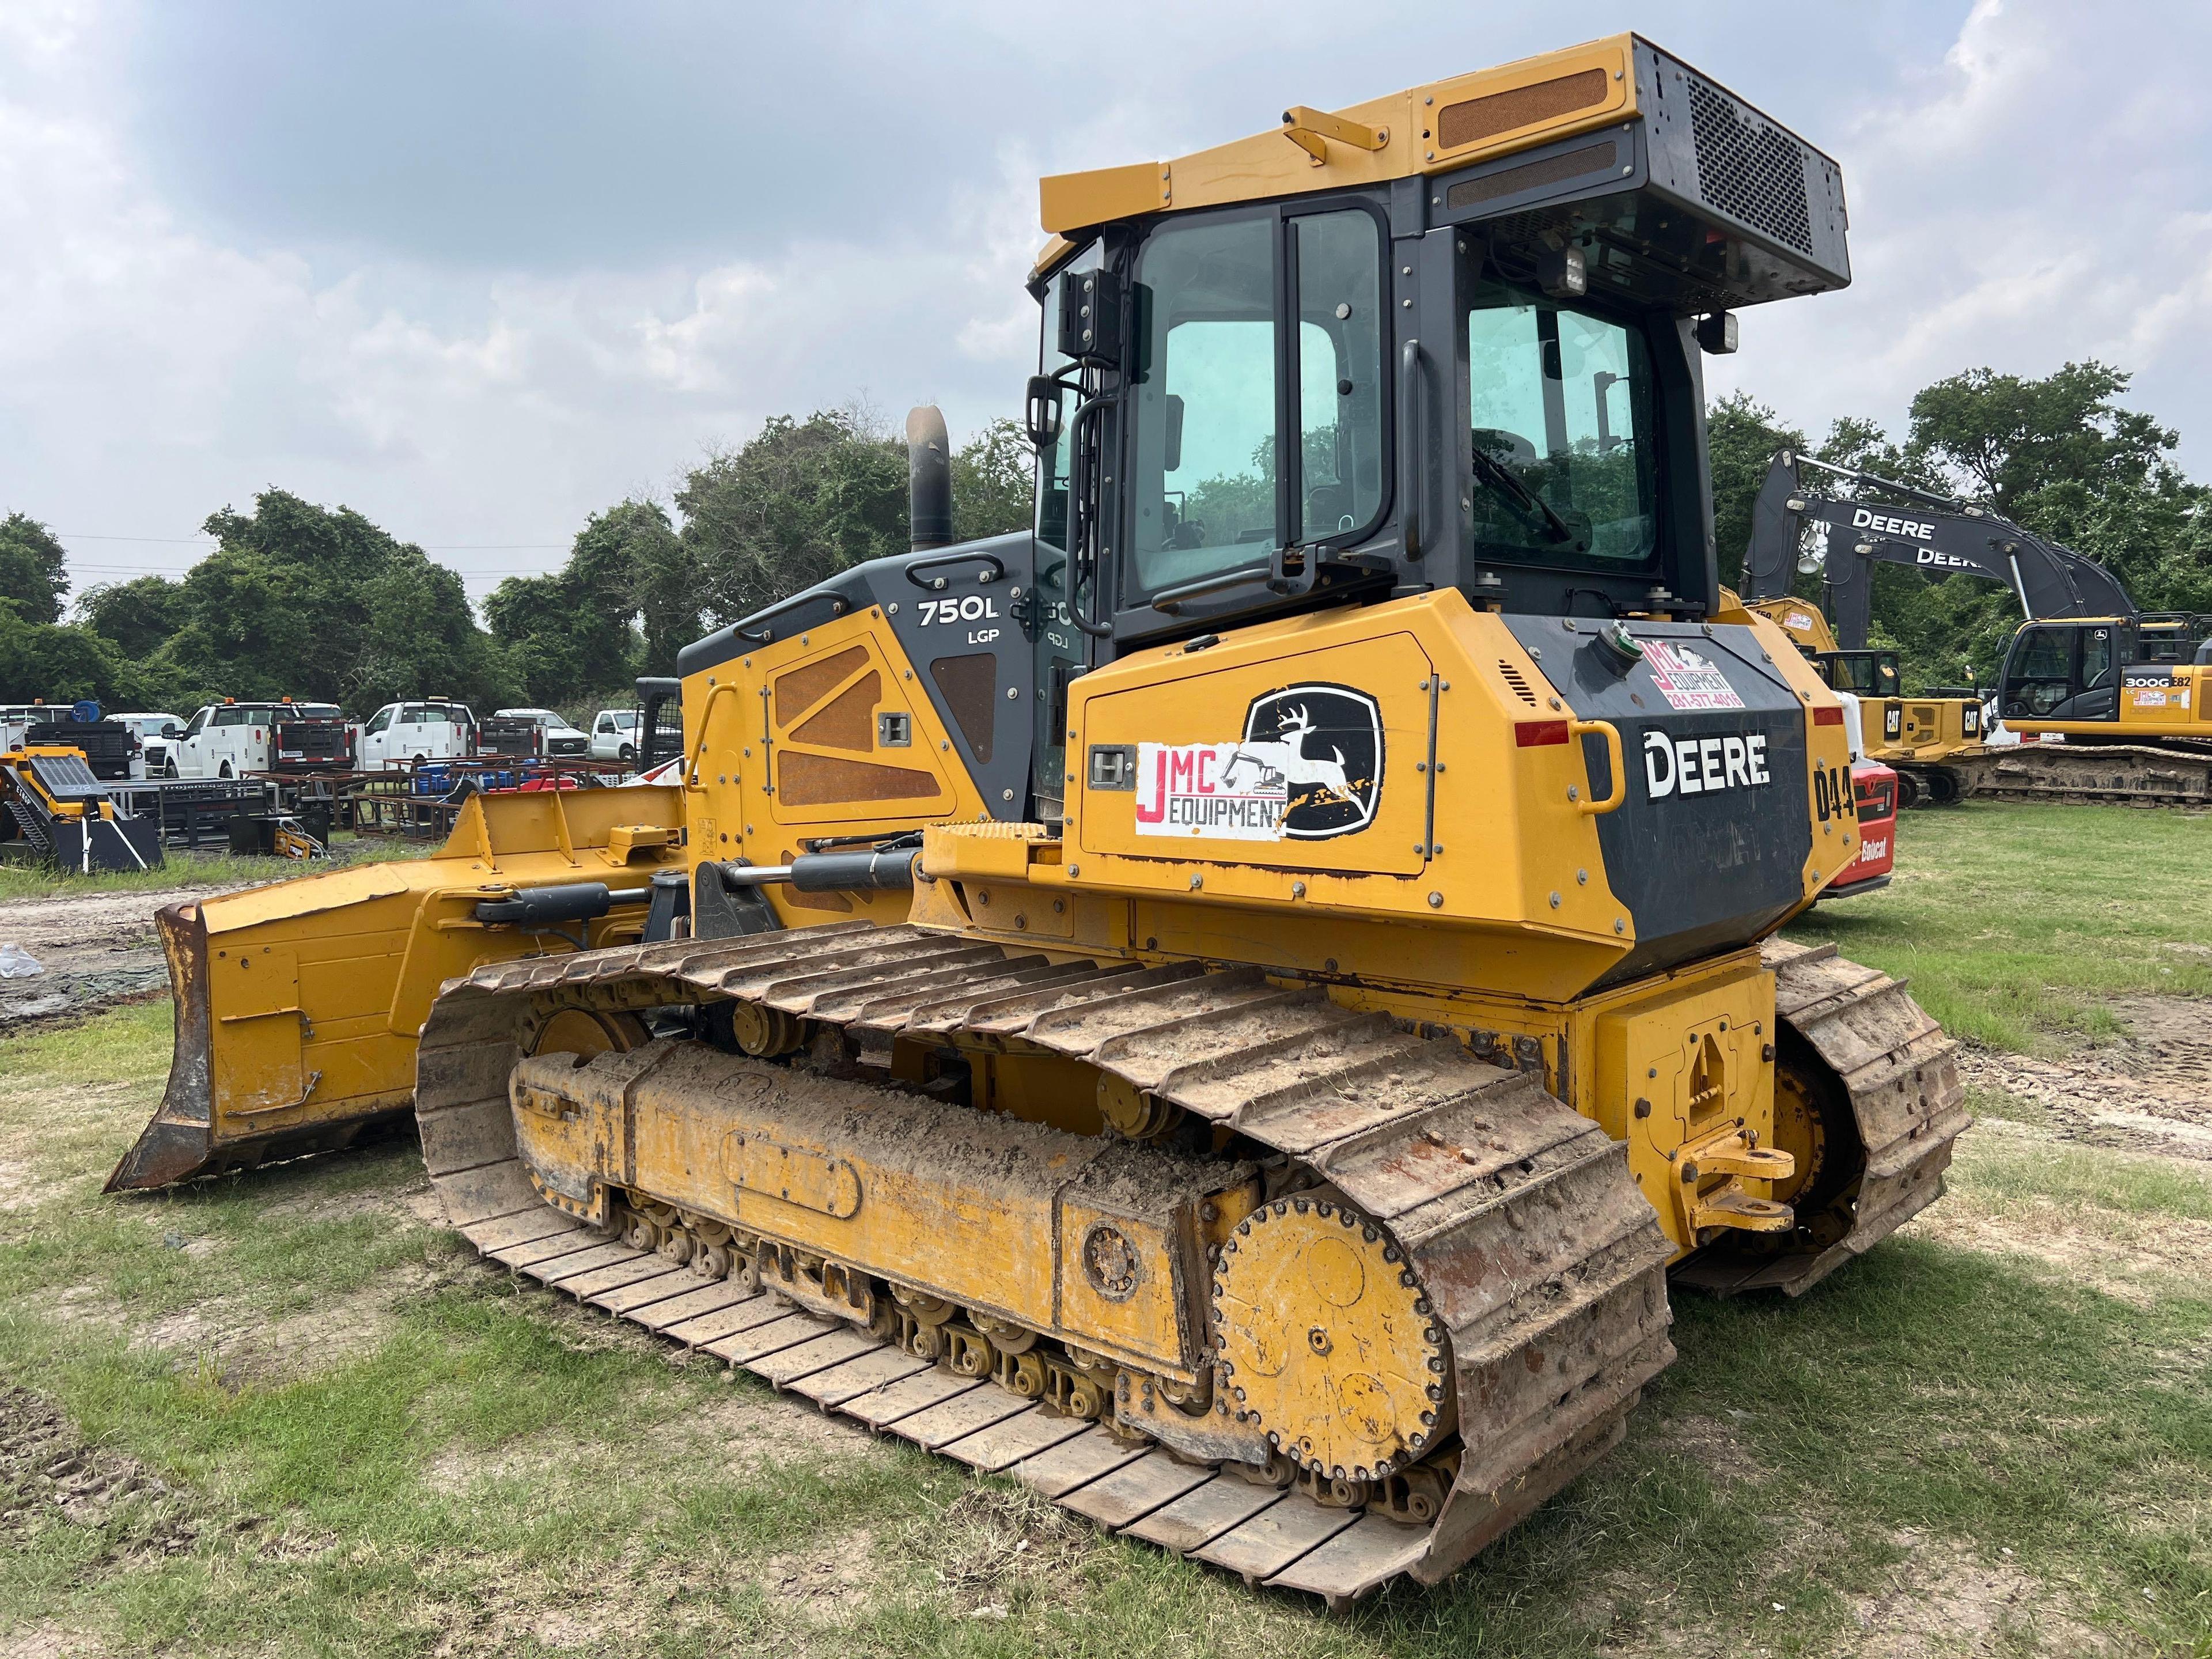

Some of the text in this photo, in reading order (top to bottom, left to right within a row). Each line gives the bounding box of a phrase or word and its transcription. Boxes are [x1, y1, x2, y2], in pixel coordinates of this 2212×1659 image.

[1852, 508, 1935, 540] DEERE
[918, 595, 1001, 627] 750L
[968, 628, 1001, 645] LGP
[1637, 641, 1684, 690] JMC
[1666, 672, 1729, 691] EQUIPMENT
[2125, 677, 2170, 688] 300G
[2172, 676, 2191, 687] E82
[1666, 693, 1743, 709] 281-577-4016
[1887, 710, 1900, 733] CAT
[1964, 710, 1978, 732] CAT
[1643, 730, 1771, 798] DEERE
[1136, 750, 1216, 823] JMC
[1813, 766, 1854, 822] D44
[1169, 797, 1286, 828] EQUIPMENT
[1861, 836, 1887, 863] Bobcat
